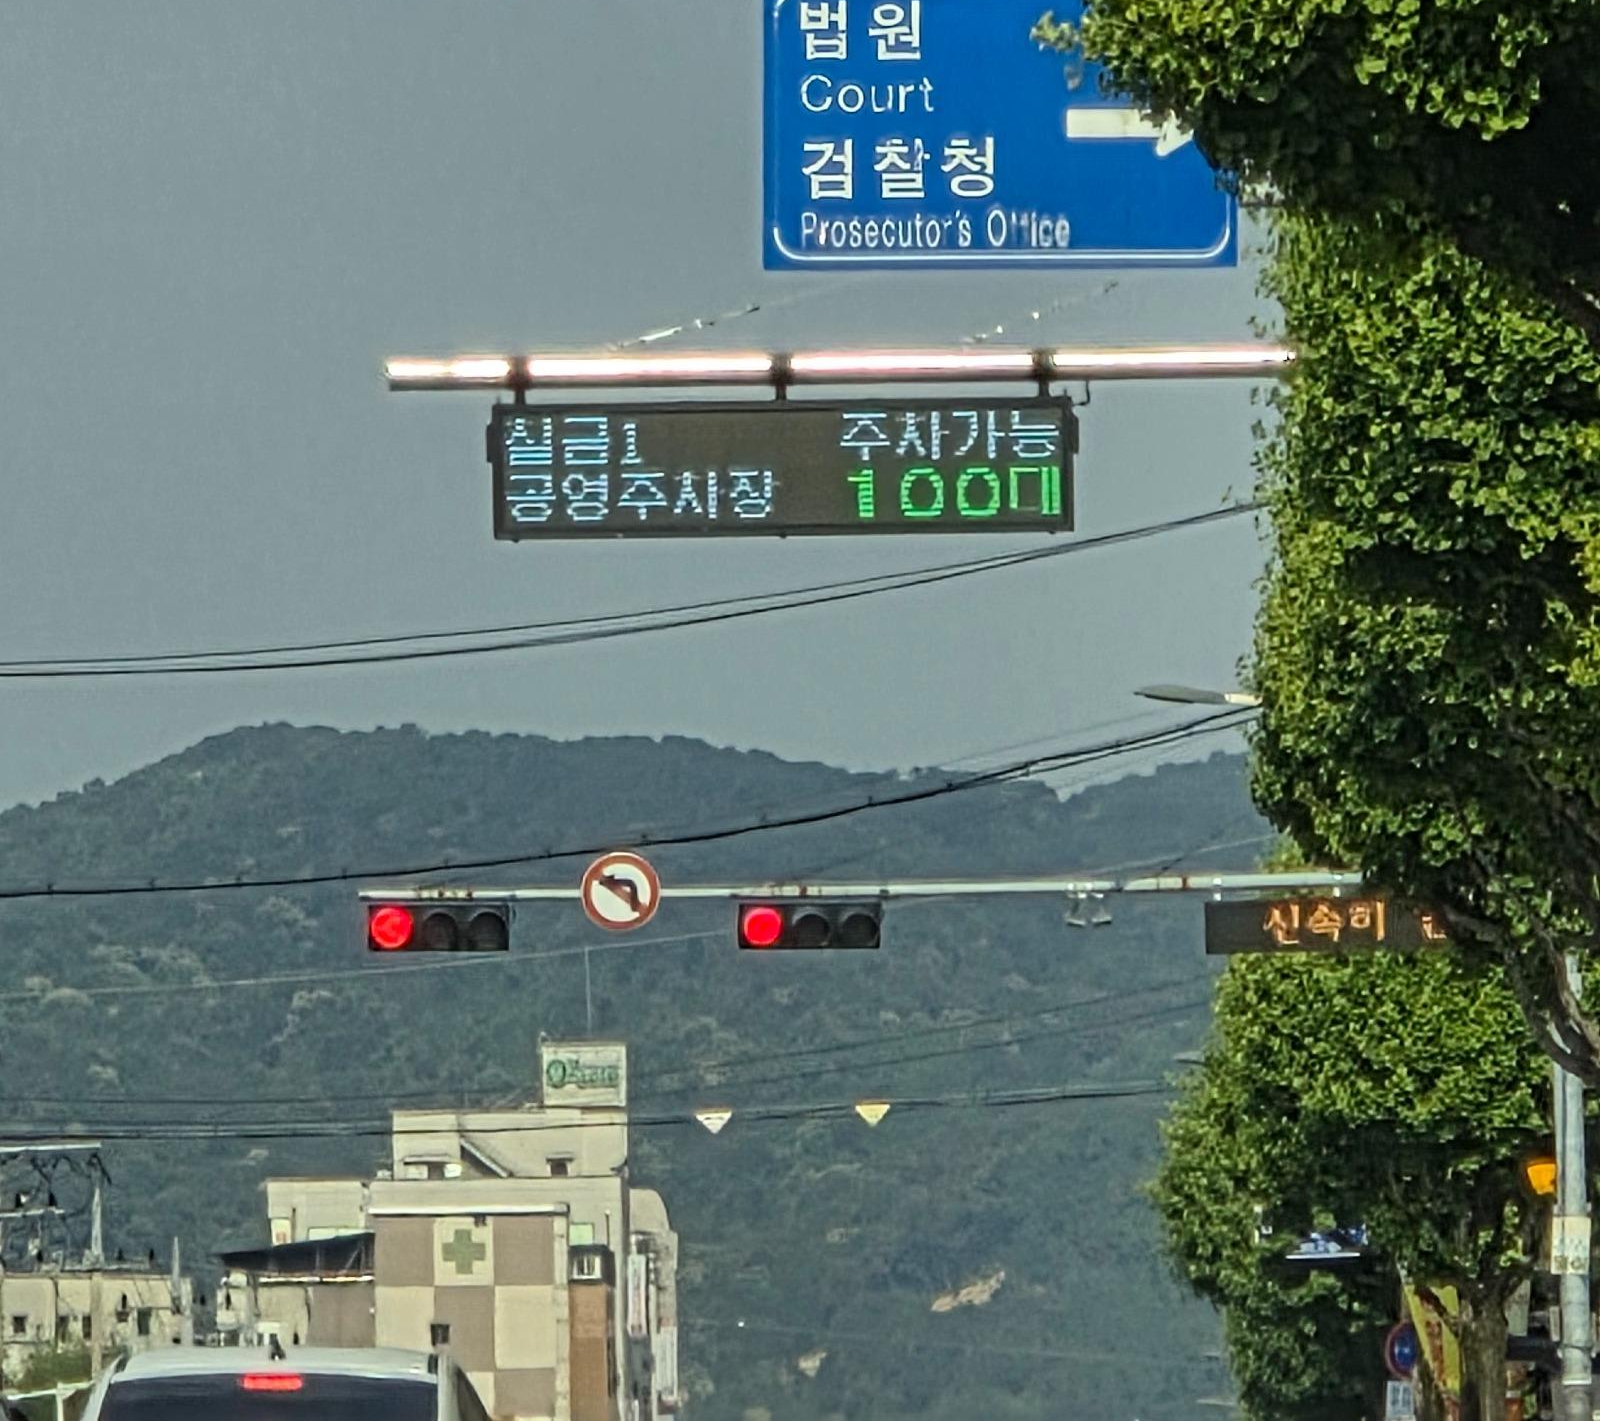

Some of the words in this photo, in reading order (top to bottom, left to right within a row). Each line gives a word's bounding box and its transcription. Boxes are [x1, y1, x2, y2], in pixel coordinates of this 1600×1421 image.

[799, 0, 922, 61] 법원
[800, 74, 936, 113] Court
[801, 136, 996, 200] 검찰청
[800, 210, 972, 249] Prosecutor's
[840, 410, 1060, 461] 주차가능
[505, 470, 780, 523] 공영주차장
[1264, 897, 1386, 947] 신속히
